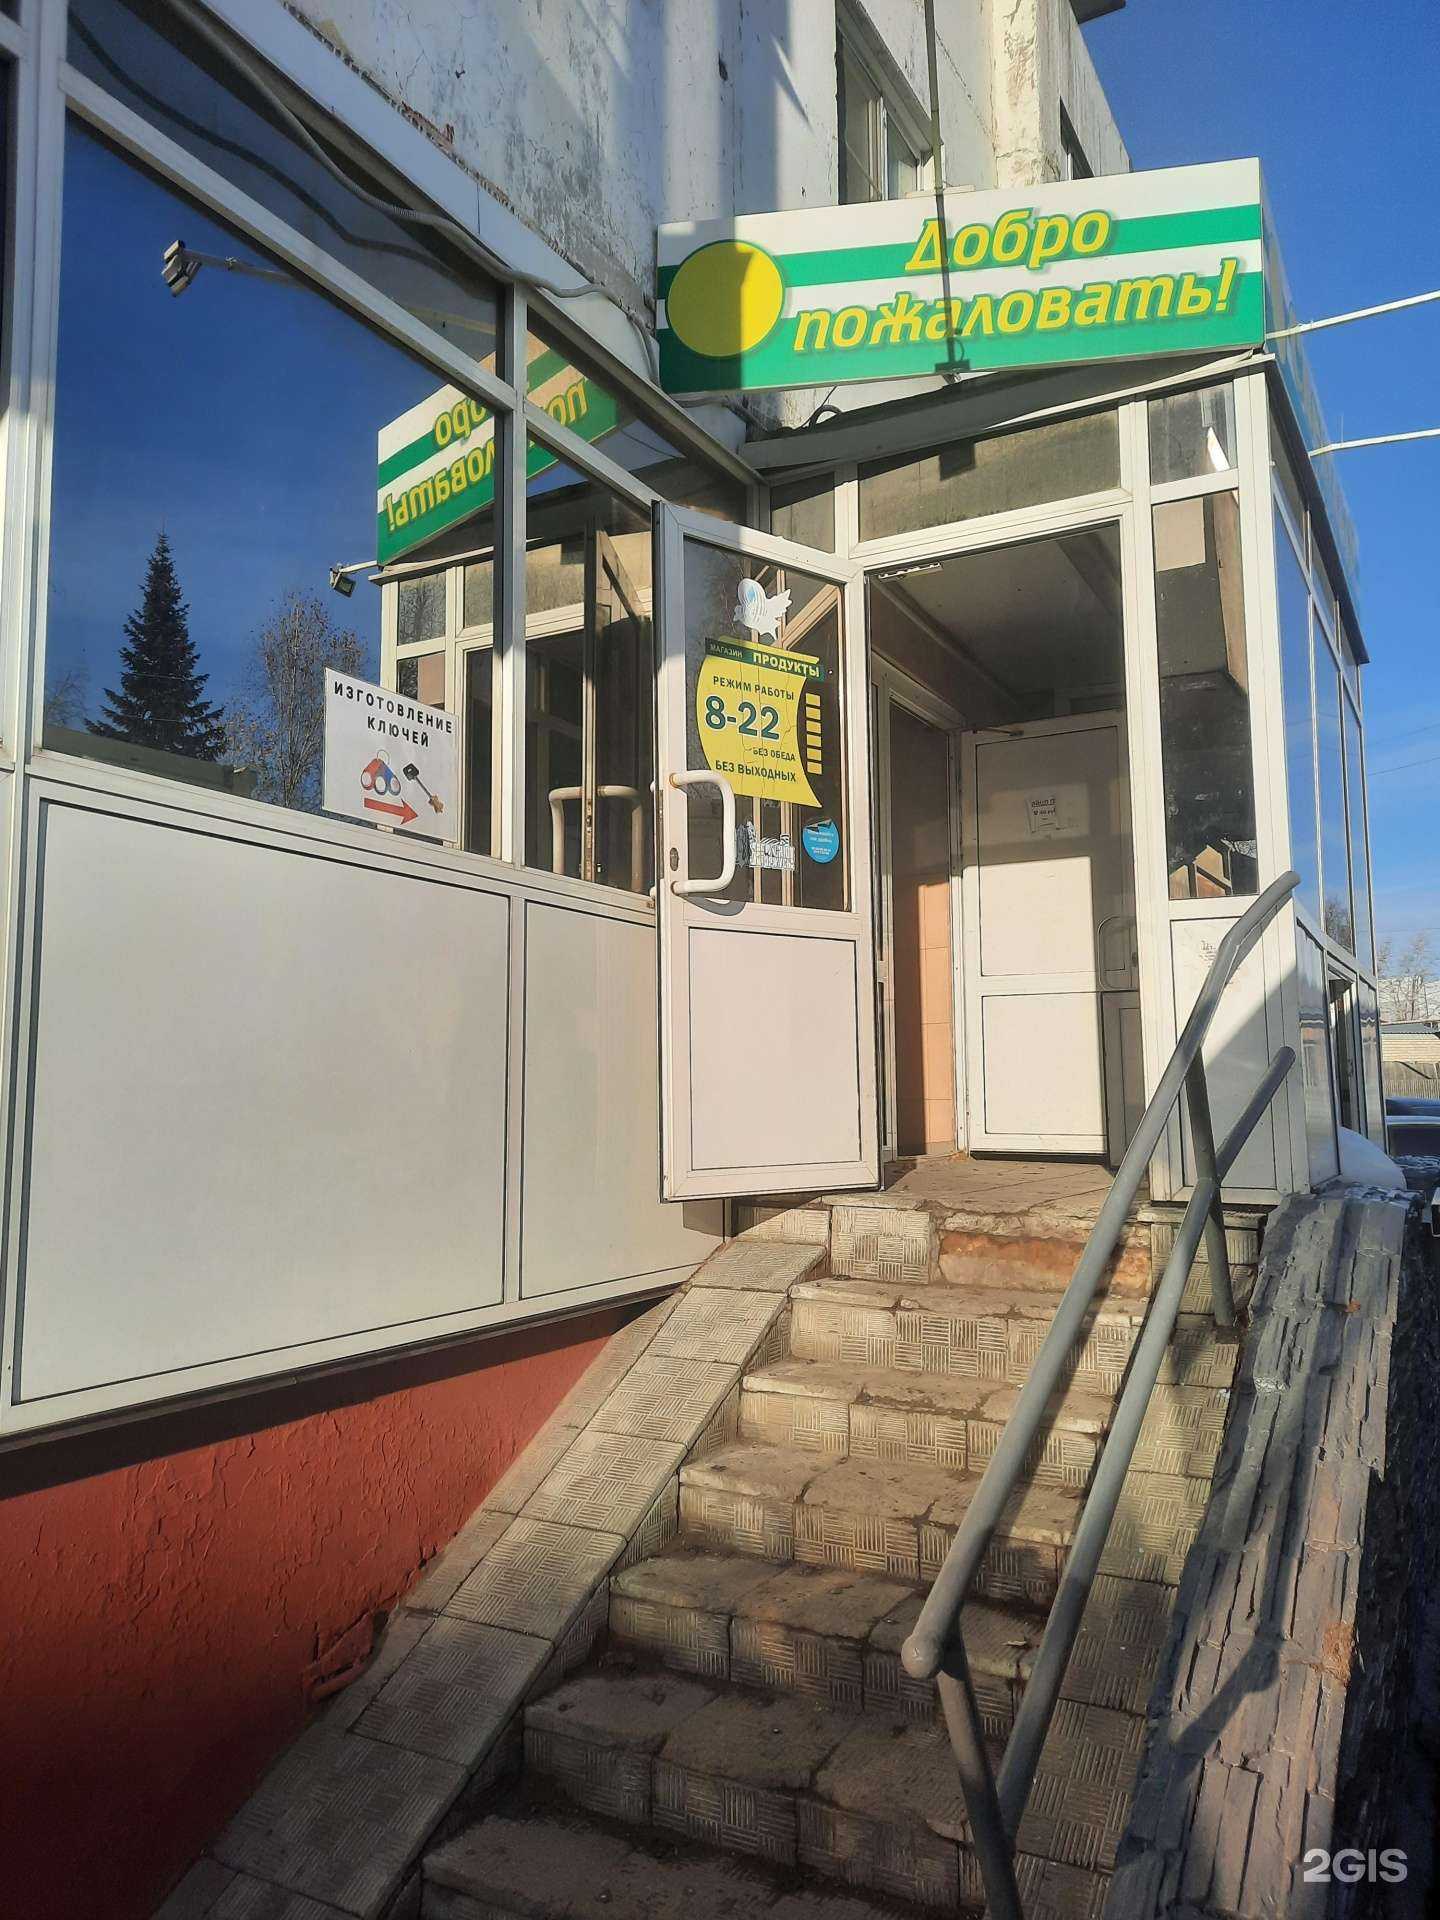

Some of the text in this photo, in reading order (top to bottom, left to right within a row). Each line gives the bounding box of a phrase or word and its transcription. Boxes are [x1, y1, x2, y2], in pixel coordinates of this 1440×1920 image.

[904, 207, 1111, 271] Добро
[792, 257, 1240, 352] пожаловать!
[753, 652, 820, 678] ПРОДУКТЫ
[713, 675, 794, 701] РЕЖИМ РАБОТЫ
[334, 681, 453, 734] ИЗГОТОВЛЕНИЕ
[705, 695, 780, 741] 8-22
[367, 716, 430, 747] КЛЮЧЕЙ
[753, 747, 796, 761] БЕЗ ОБЕДА
[715, 760, 797, 782] БЕЗ ВЫХОДНЫХ
